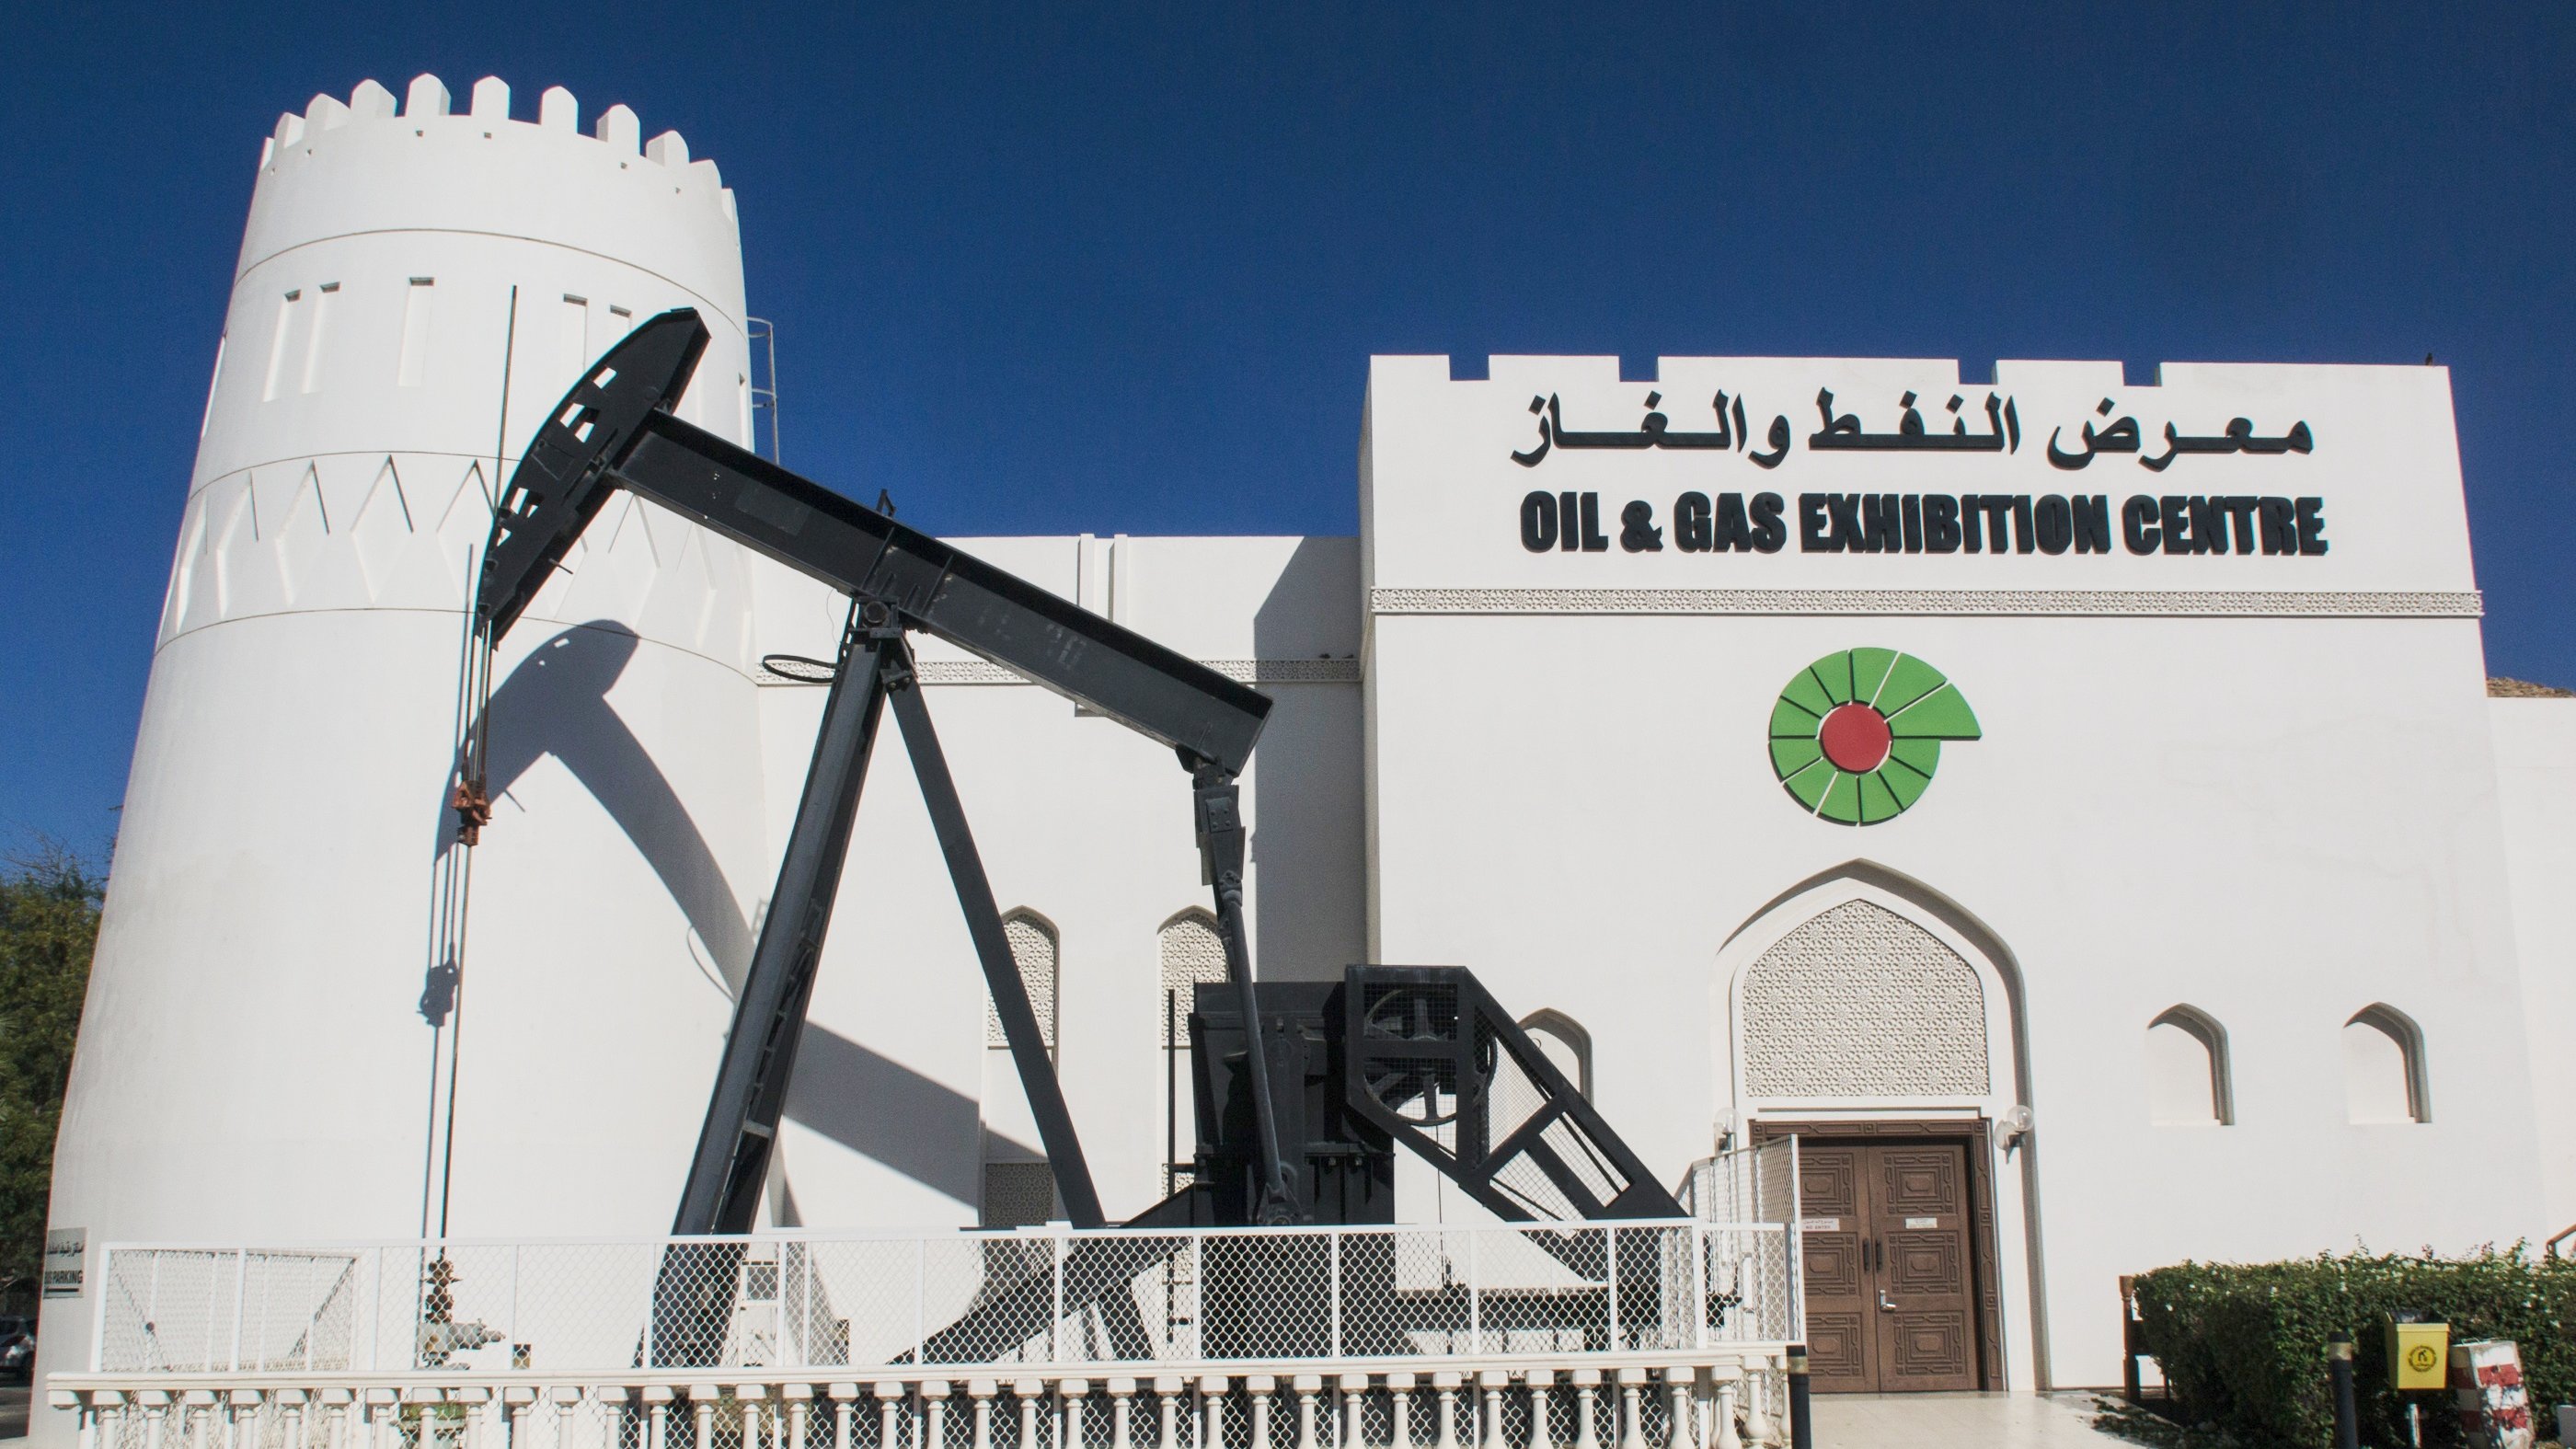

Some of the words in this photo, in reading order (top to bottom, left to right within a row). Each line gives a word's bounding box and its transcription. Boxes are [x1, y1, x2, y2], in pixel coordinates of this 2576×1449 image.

[1510, 388, 1791, 469] والغاز
[1809, 386, 2021, 455] النفط
[2047, 397, 2314, 473] معرض
[1520, 490, 1609, 553] OIL
[1620, 500, 1663, 553] &
[1673, 490, 1787, 554] GAS
[1798, 493, 2111, 555] EXHIBITION
[2122, 494, 2329, 557] CENTRE
[52, 1270, 84, 1284] PARKING
